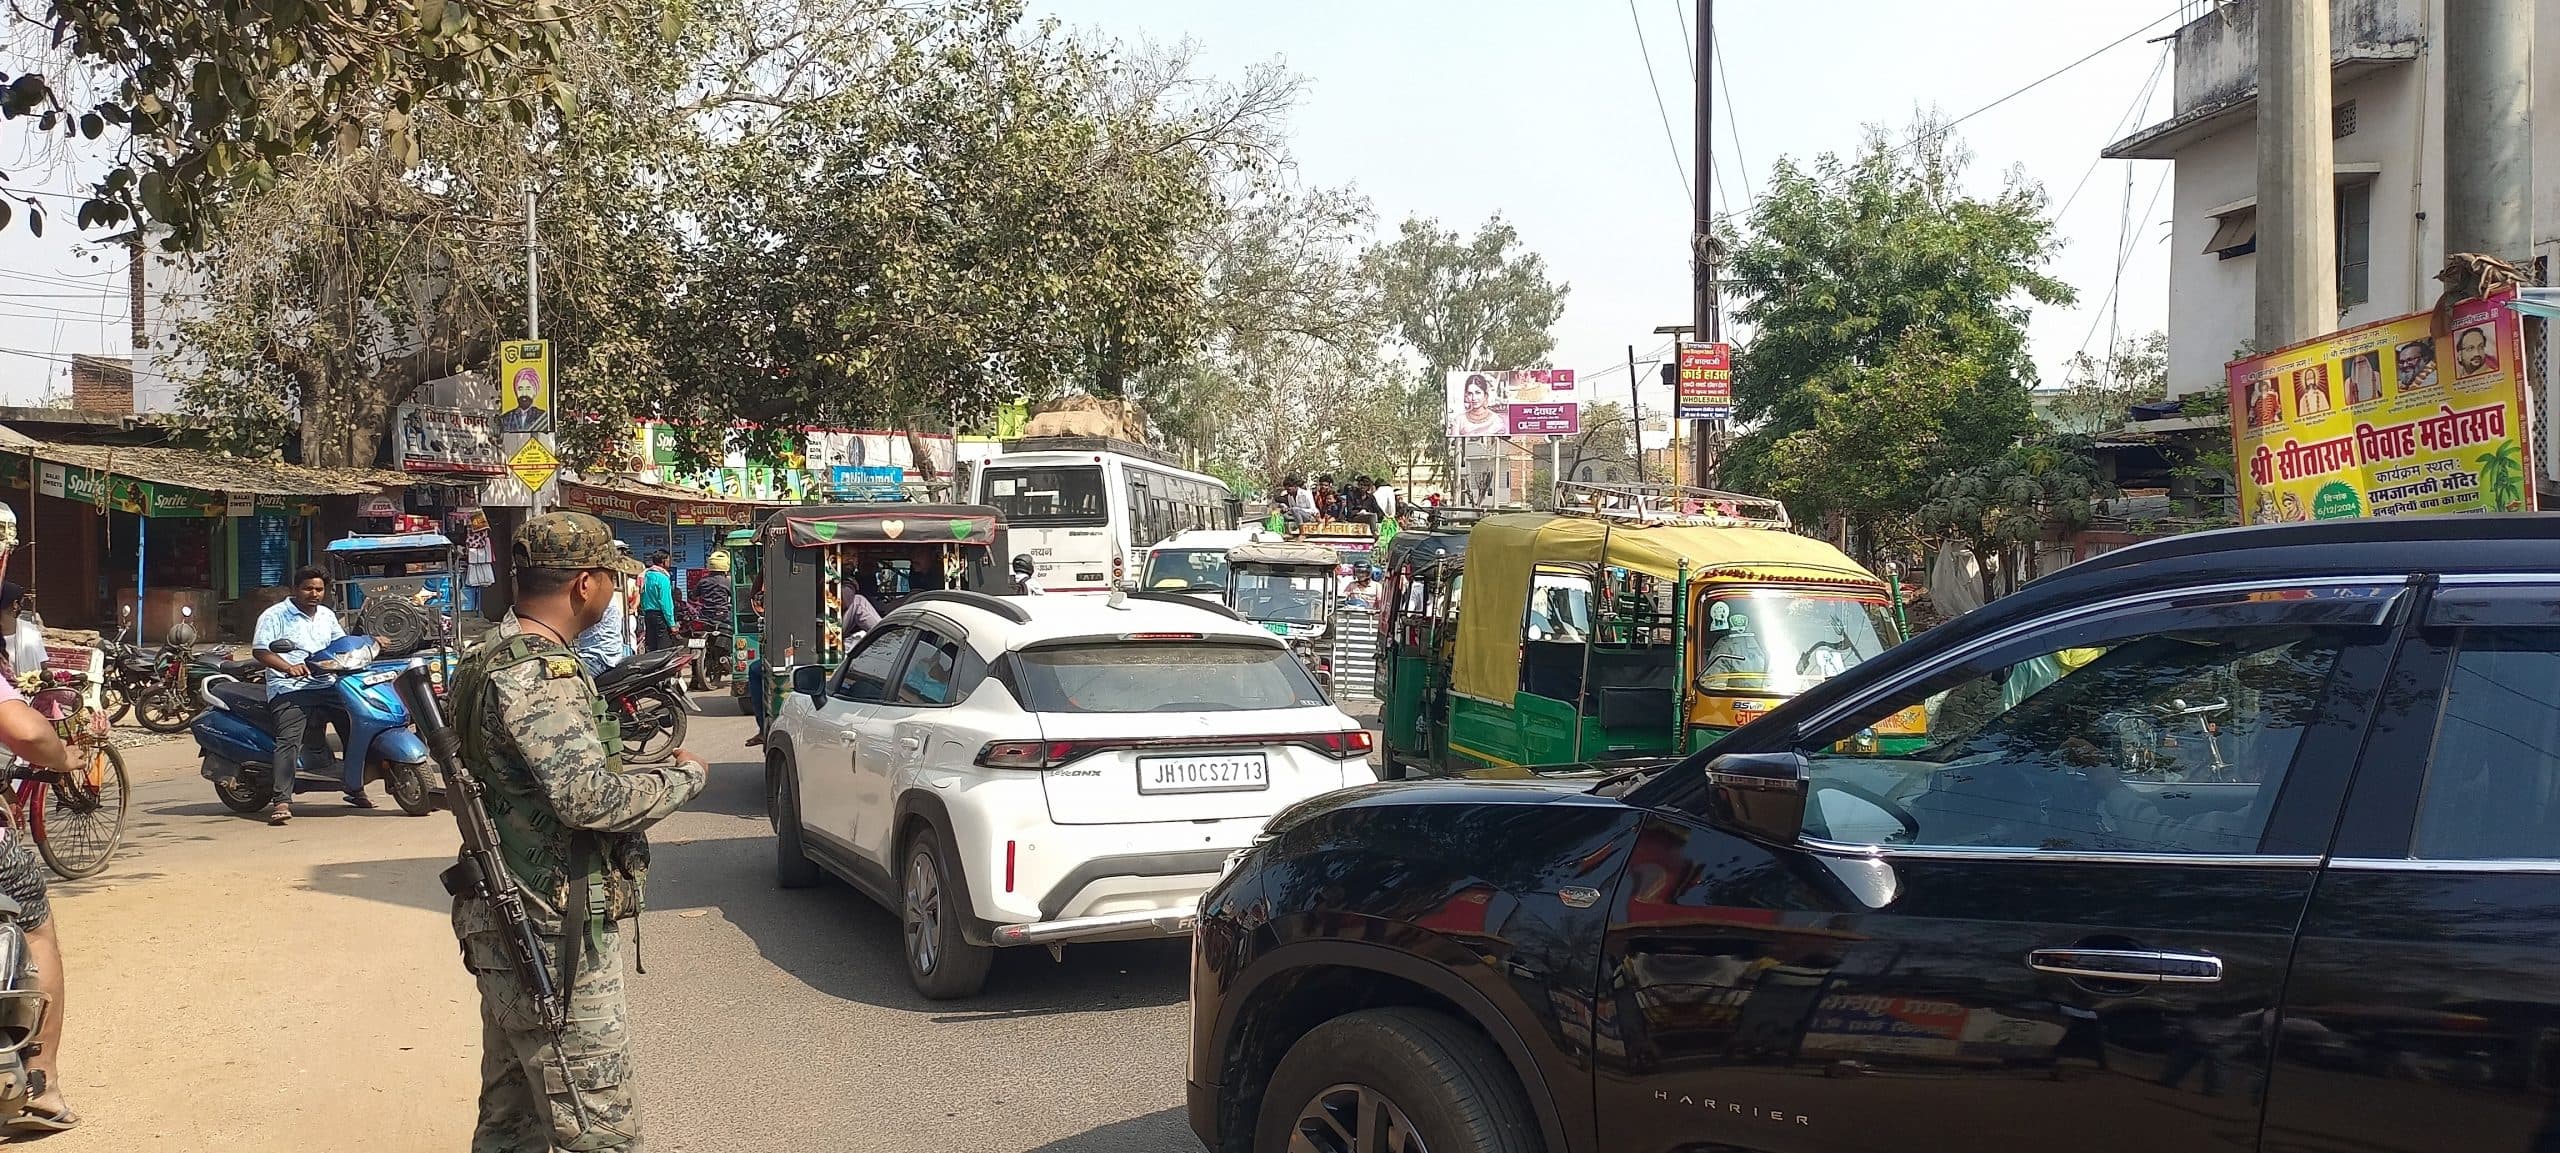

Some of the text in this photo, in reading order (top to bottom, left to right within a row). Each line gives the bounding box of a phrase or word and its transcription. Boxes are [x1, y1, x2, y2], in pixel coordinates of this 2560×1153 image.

[1683, 366, 1728, 380] कार्ड हाउस
[1533, 405, 1557, 416] देवघर
[2250, 404, 2505, 486] श्री सीताराम विवाह महोत्सव
[2375, 465, 2421, 483] कार्यक्रम
[43, 480, 63, 489] SWEETS
[2368, 472, 2478, 504] रामजानकी मंदिर
[155, 494, 188, 507] Sprite
[257, 494, 285, 507] Sprit
[584, 492, 633, 510] देवघरिया
[2442, 494, 2455, 506] का
[689, 503, 725, 516] देवघरिया
[2317, 504, 2356, 517] 6/12/2024
[643, 533, 687, 546] PESI
[1050, 769, 1102, 777] FRONX
[1155, 761, 1263, 784] JH10CS2713
[1654, 1090, 1809, 1126] HARRIER
